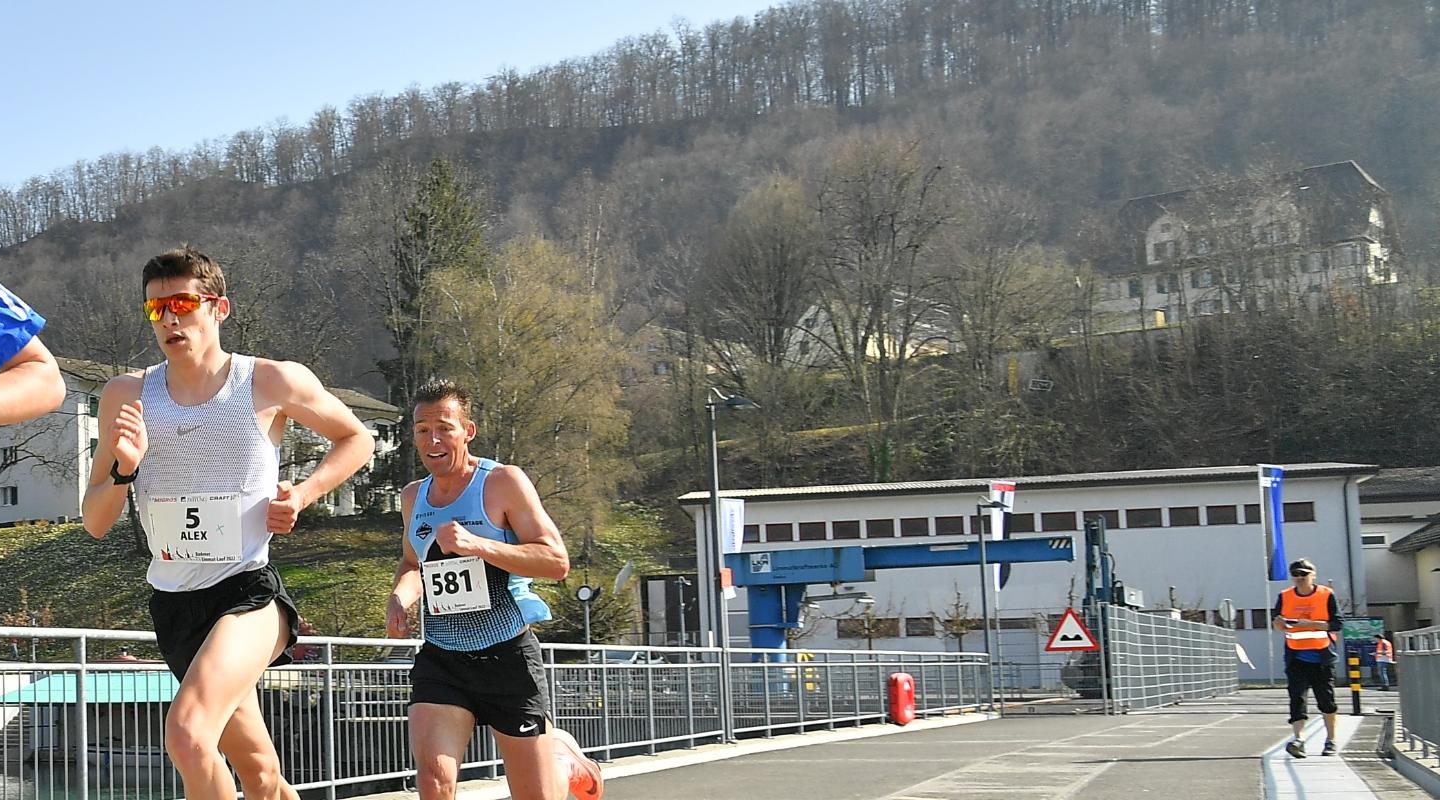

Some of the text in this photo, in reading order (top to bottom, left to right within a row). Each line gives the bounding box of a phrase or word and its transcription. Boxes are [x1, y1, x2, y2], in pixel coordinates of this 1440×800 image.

[186, 507, 200, 529] 5
[180, 531, 208, 541] ALEX
[431, 569, 473, 596] 581
